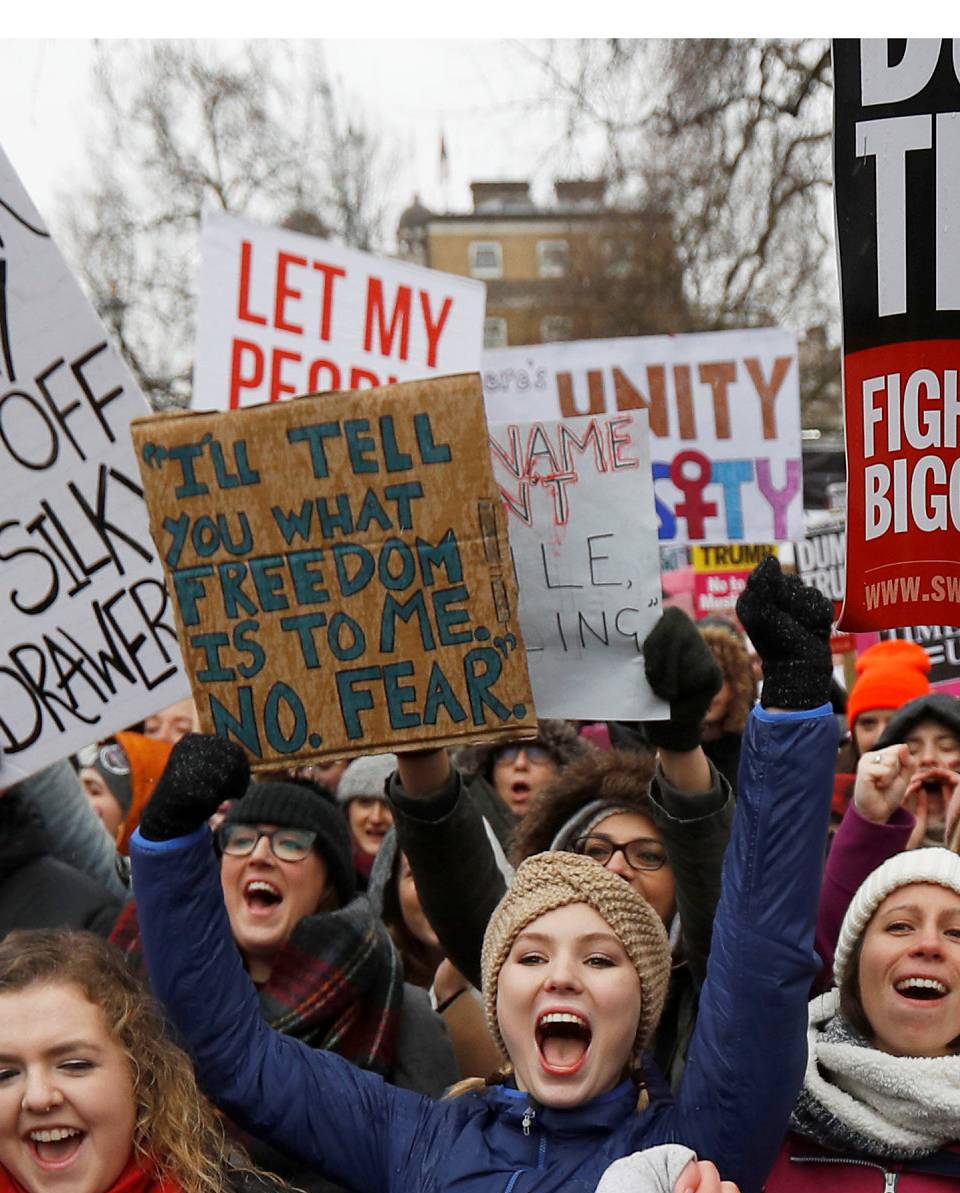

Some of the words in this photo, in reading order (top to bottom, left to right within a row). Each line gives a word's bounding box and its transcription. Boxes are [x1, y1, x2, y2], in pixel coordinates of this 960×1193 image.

[237, 240, 347, 343] LET
[362, 275, 454, 369] MY
[0, 341, 124, 470] OFF
[556, 354, 794, 441] UNITY
[286, 411, 452, 479] TELL
[162, 511, 254, 569] YOU
[271, 481, 425, 546] WHAT
[496, 470, 579, 527] N'T
[172, 527, 465, 627] FREEDOM
[190, 618, 267, 683] IS
[280, 610, 367, 671] TO
[208, 680, 323, 760] NO.
